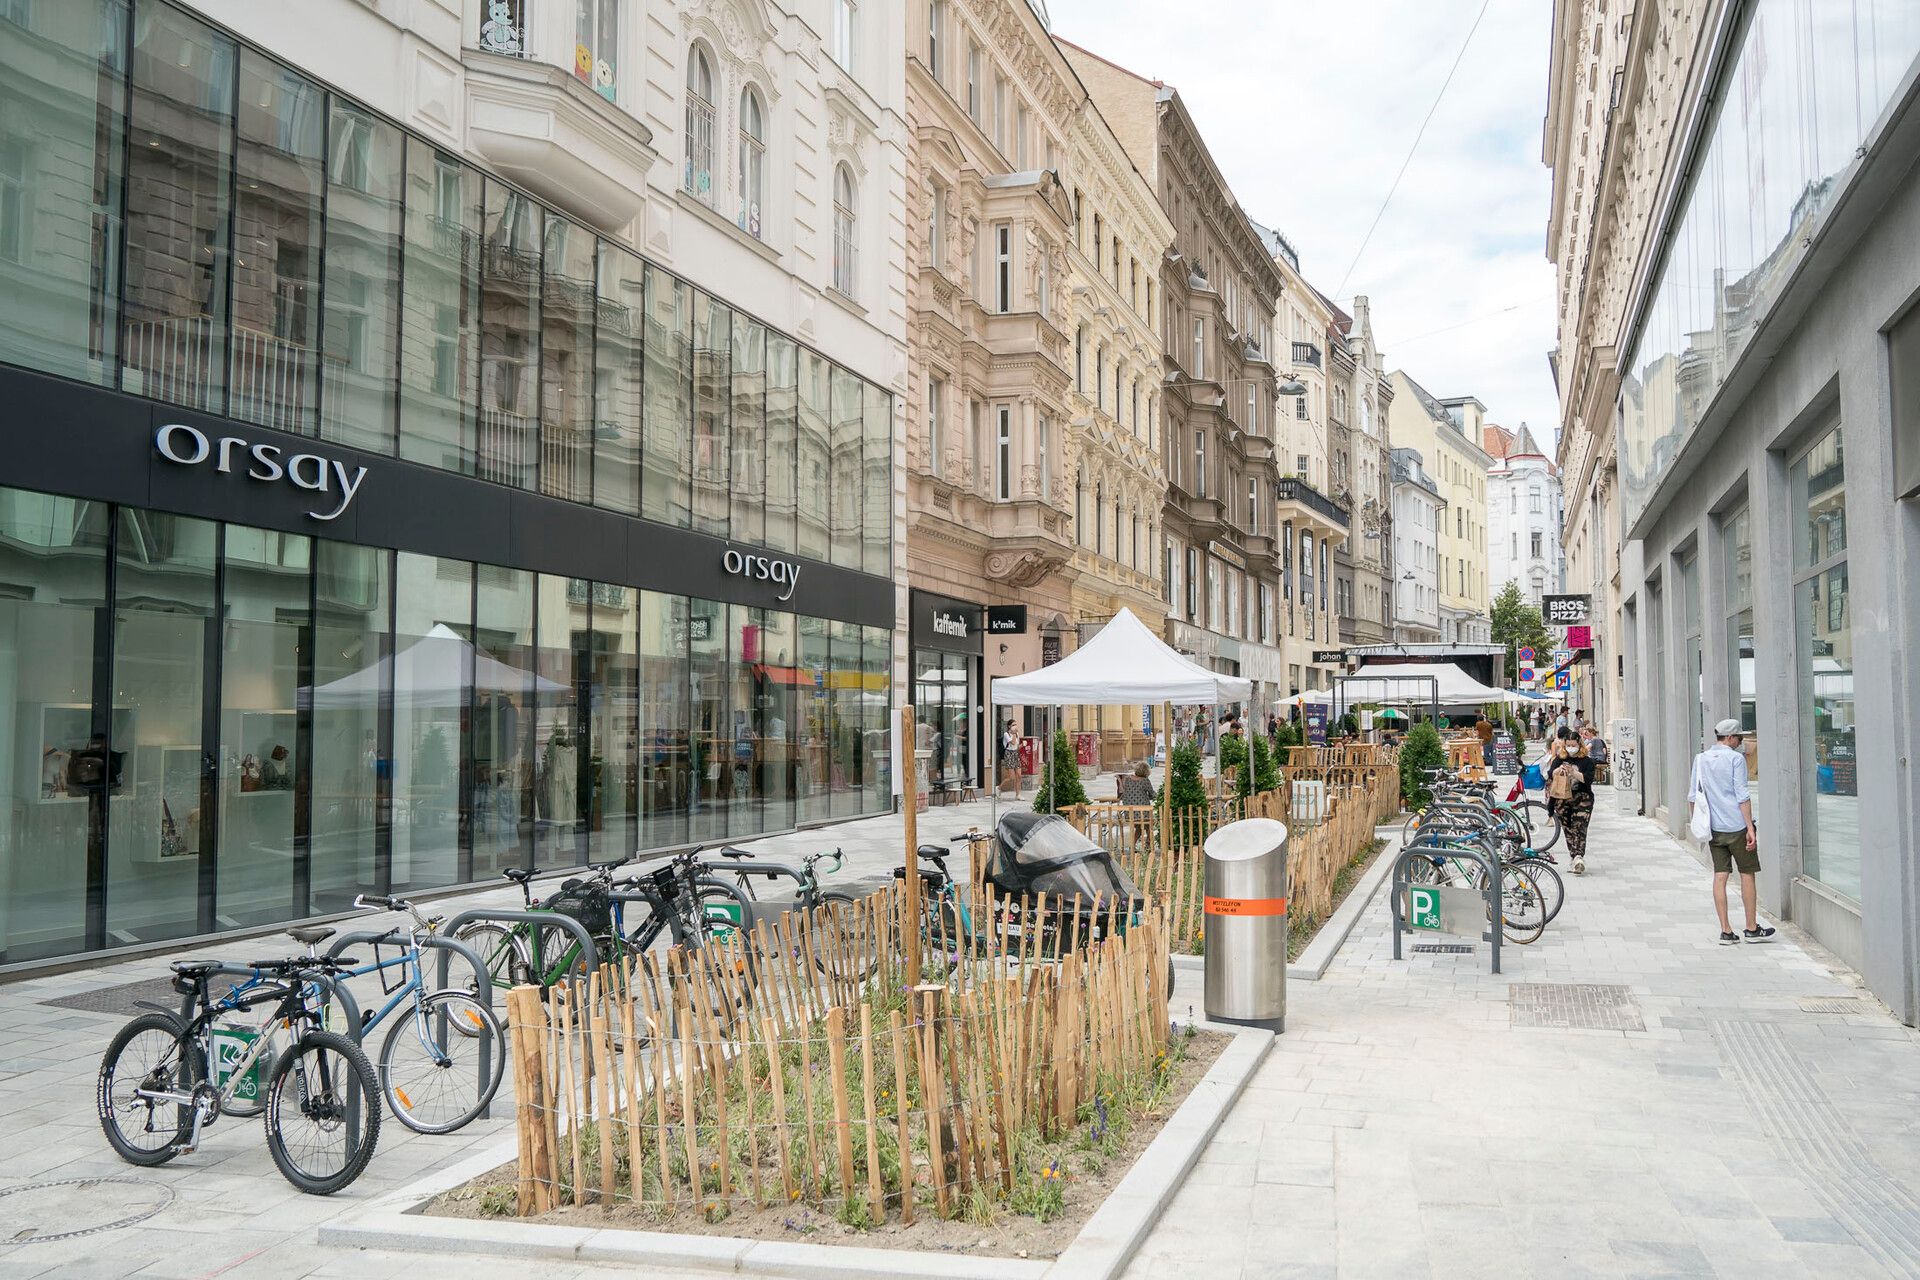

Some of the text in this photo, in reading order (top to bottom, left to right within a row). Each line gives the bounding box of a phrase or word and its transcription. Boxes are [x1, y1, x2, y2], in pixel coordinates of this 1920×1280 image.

[155, 424, 368, 520] orsay
[723, 550, 801, 601] orsay
[1550, 601, 1588, 611] BROS.
[1550, 611, 1586, 620] PIZZA
[1319, 652, 1342, 662] johan
[1412, 890, 1433, 925] P
